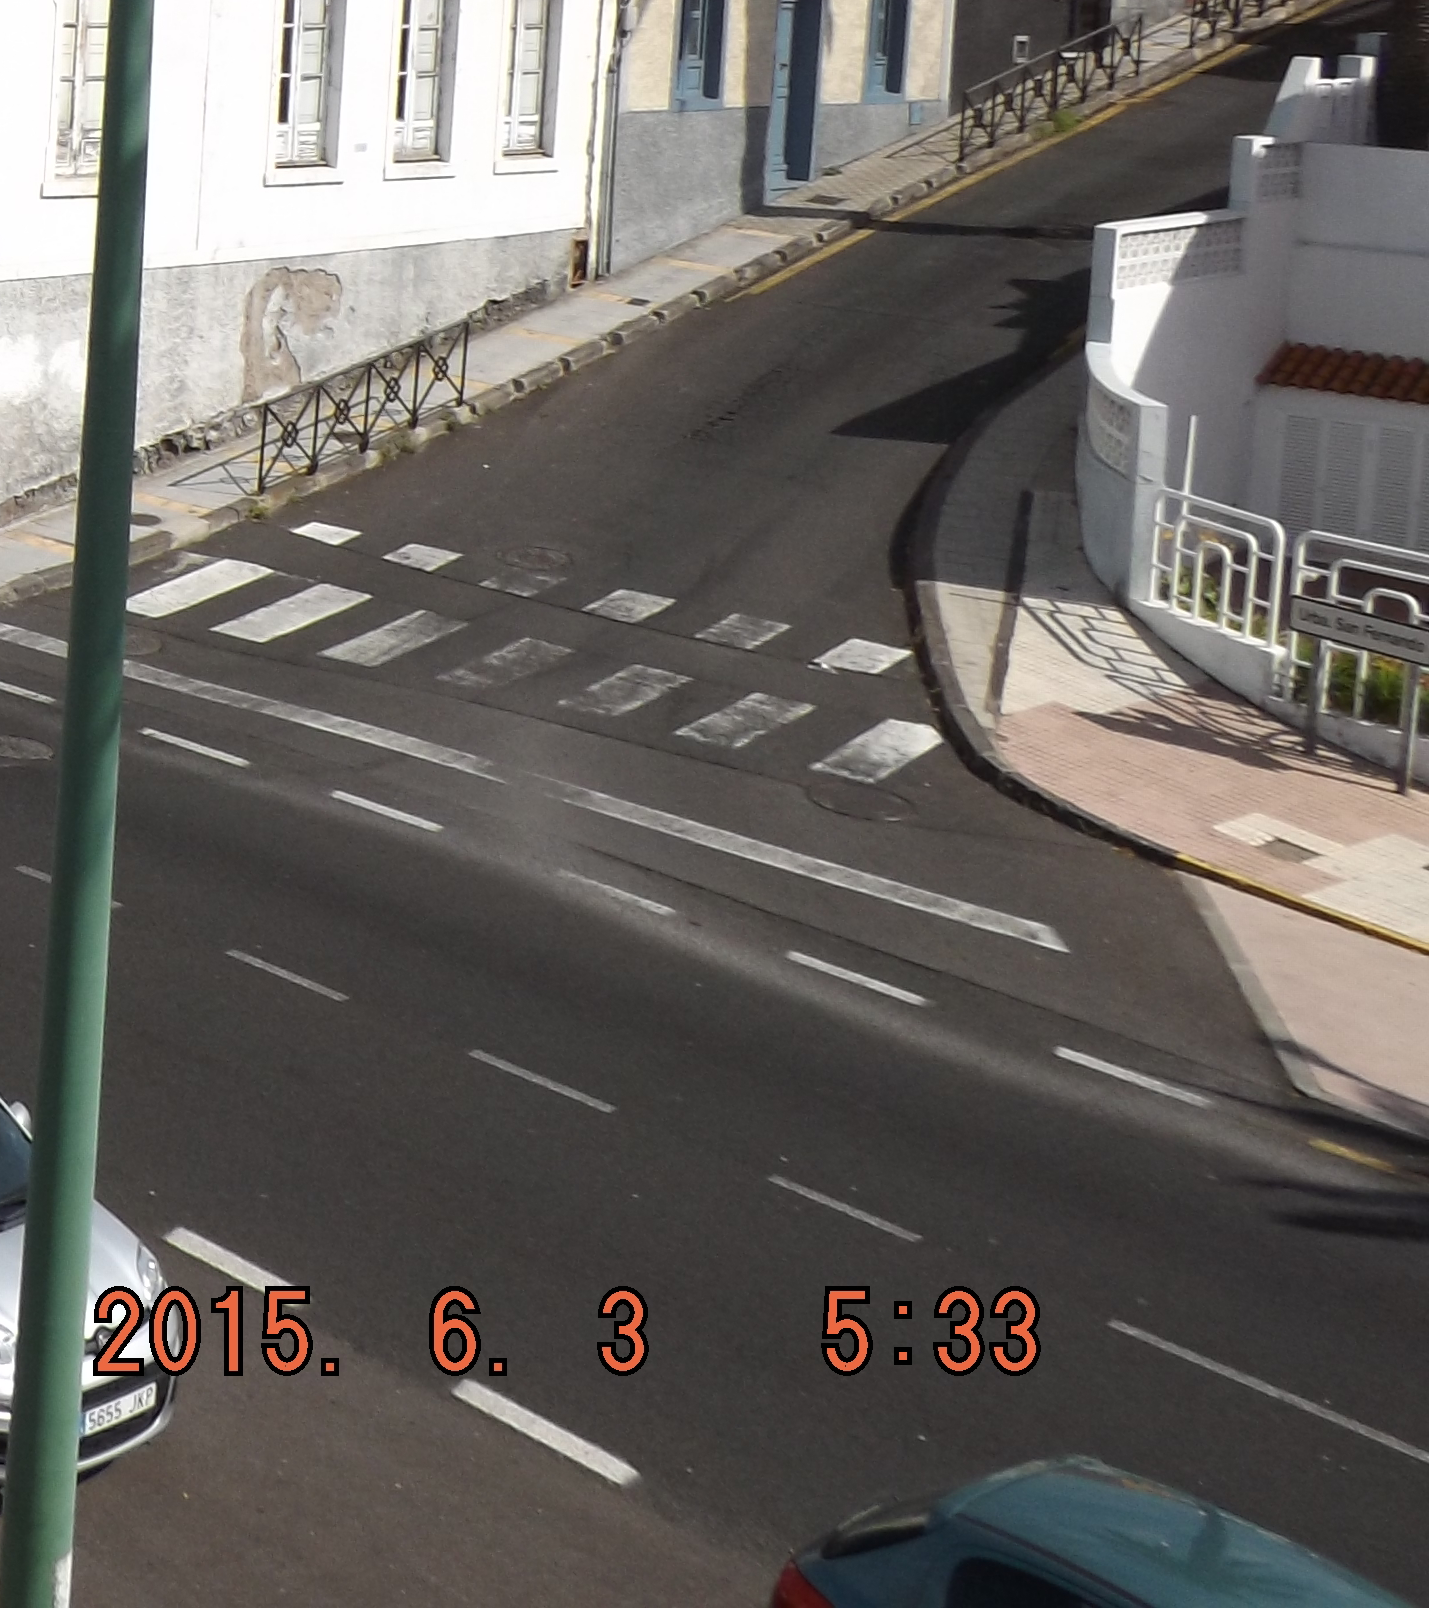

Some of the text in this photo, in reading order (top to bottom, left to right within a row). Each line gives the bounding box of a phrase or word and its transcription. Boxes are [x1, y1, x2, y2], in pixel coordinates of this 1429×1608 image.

[1335, 616, 1360, 635] San
[88, 1386, 154, 1431] 5655 JKP
